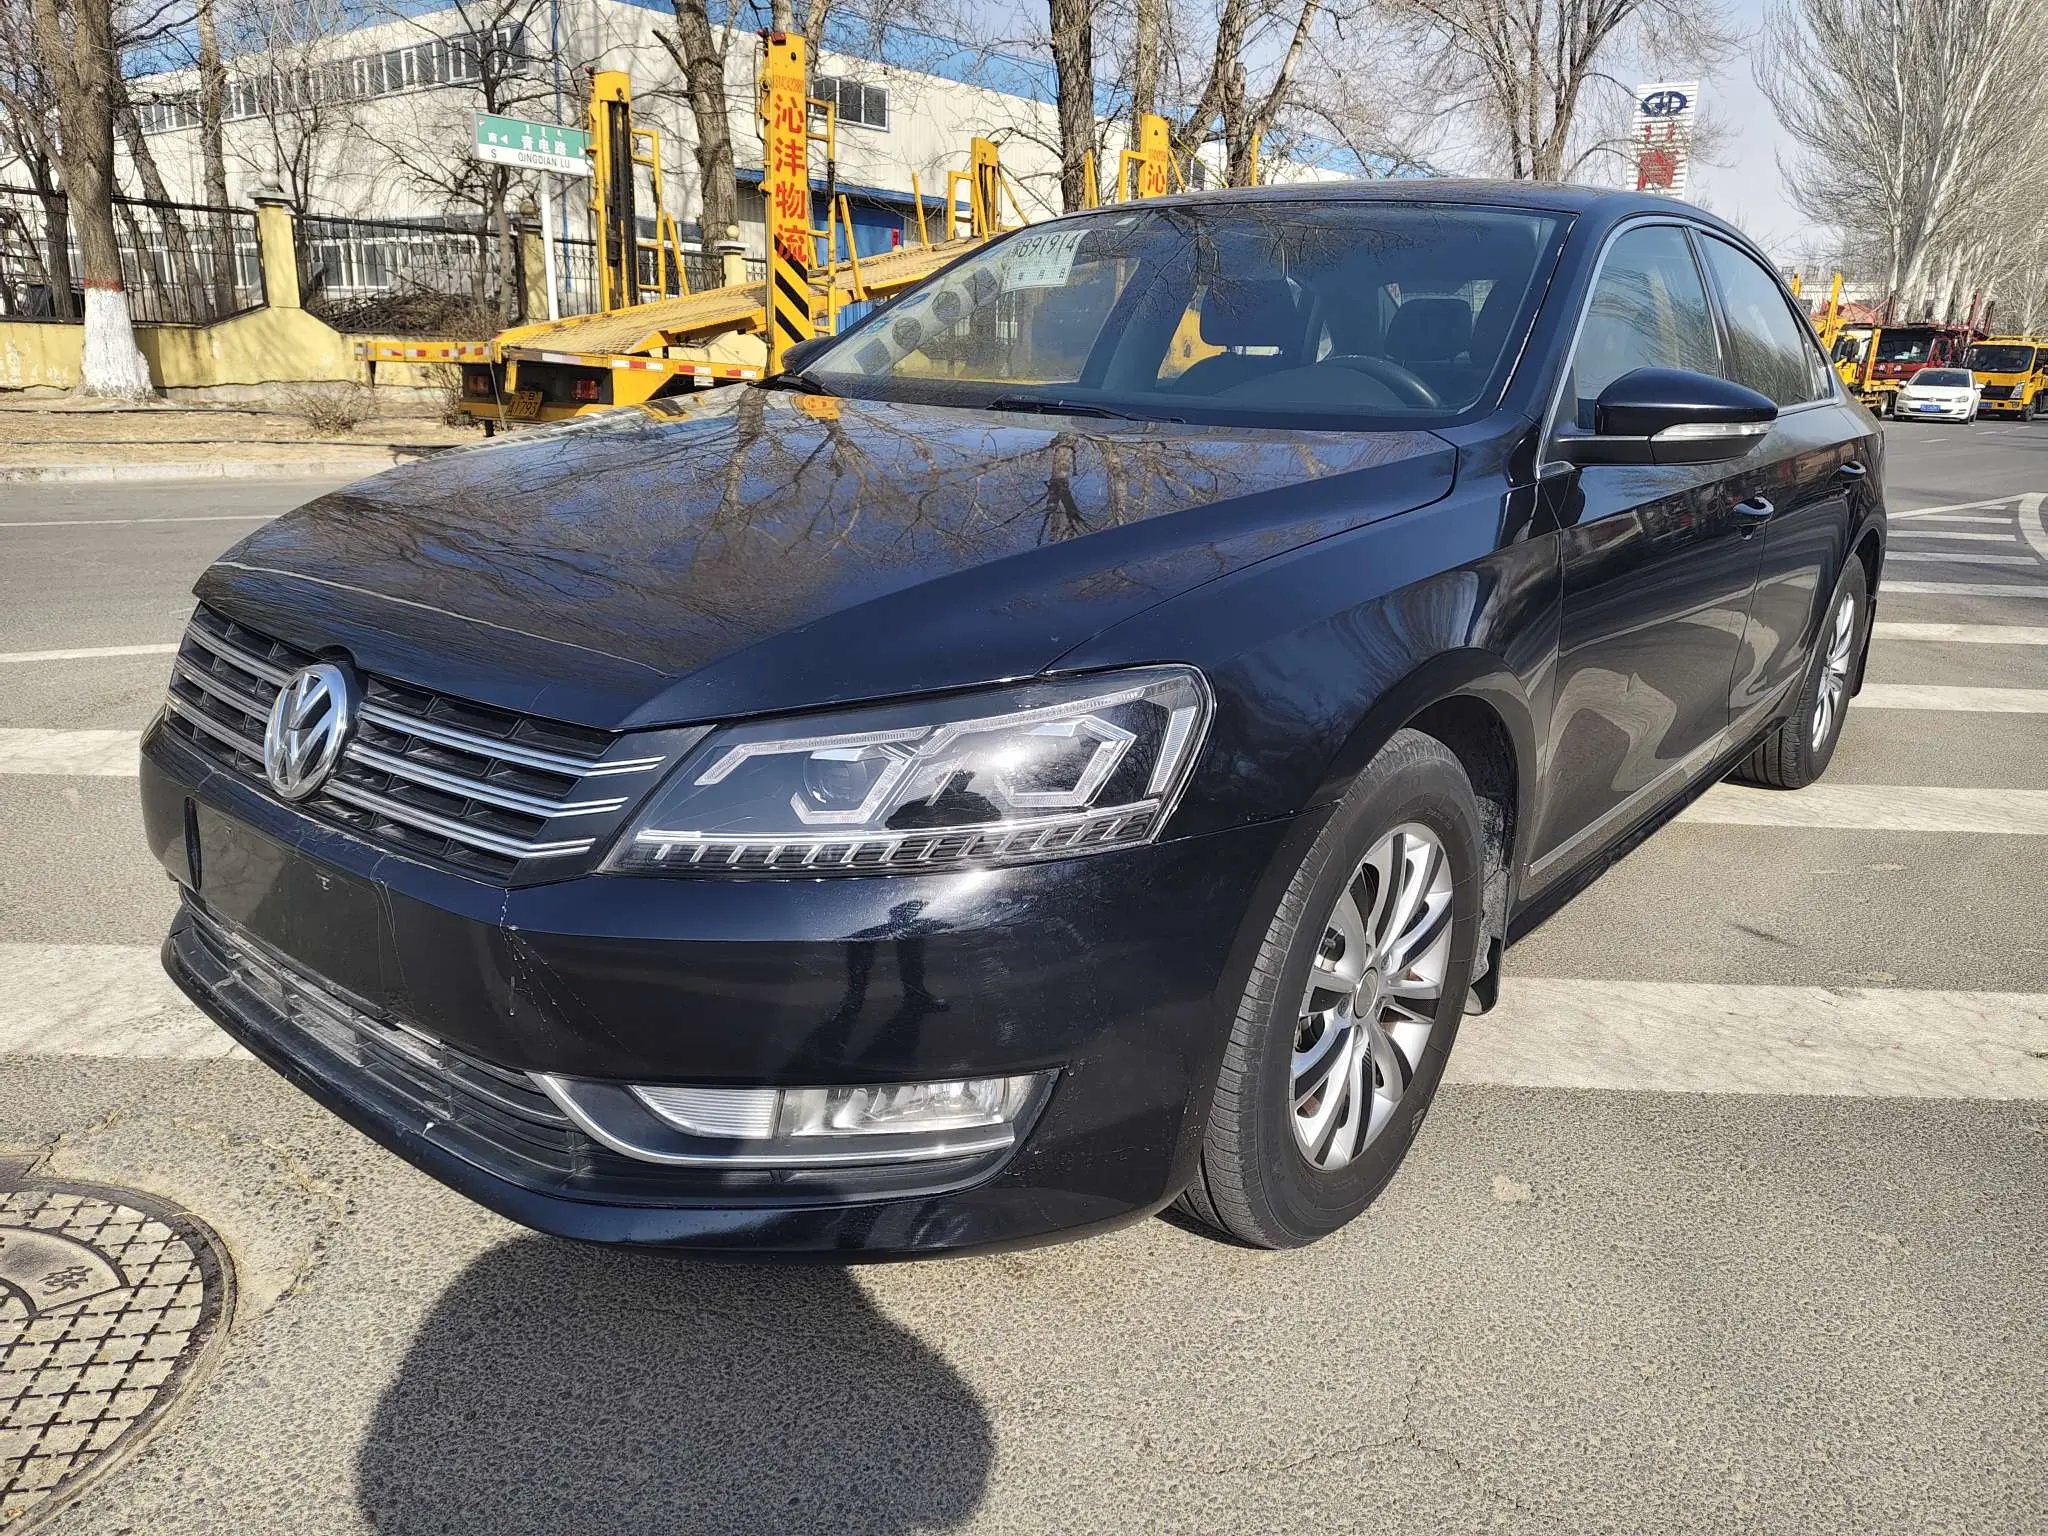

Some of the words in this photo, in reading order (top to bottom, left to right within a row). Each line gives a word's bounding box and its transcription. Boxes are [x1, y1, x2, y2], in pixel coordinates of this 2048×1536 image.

[490, 148, 497, 159] S
[517, 151, 557, 168] QINGDIAN
[560, 158, 570, 169] LU
[774, 94, 807, 263] 沁沣物流
[1147, 163, 1166, 194] 沁
